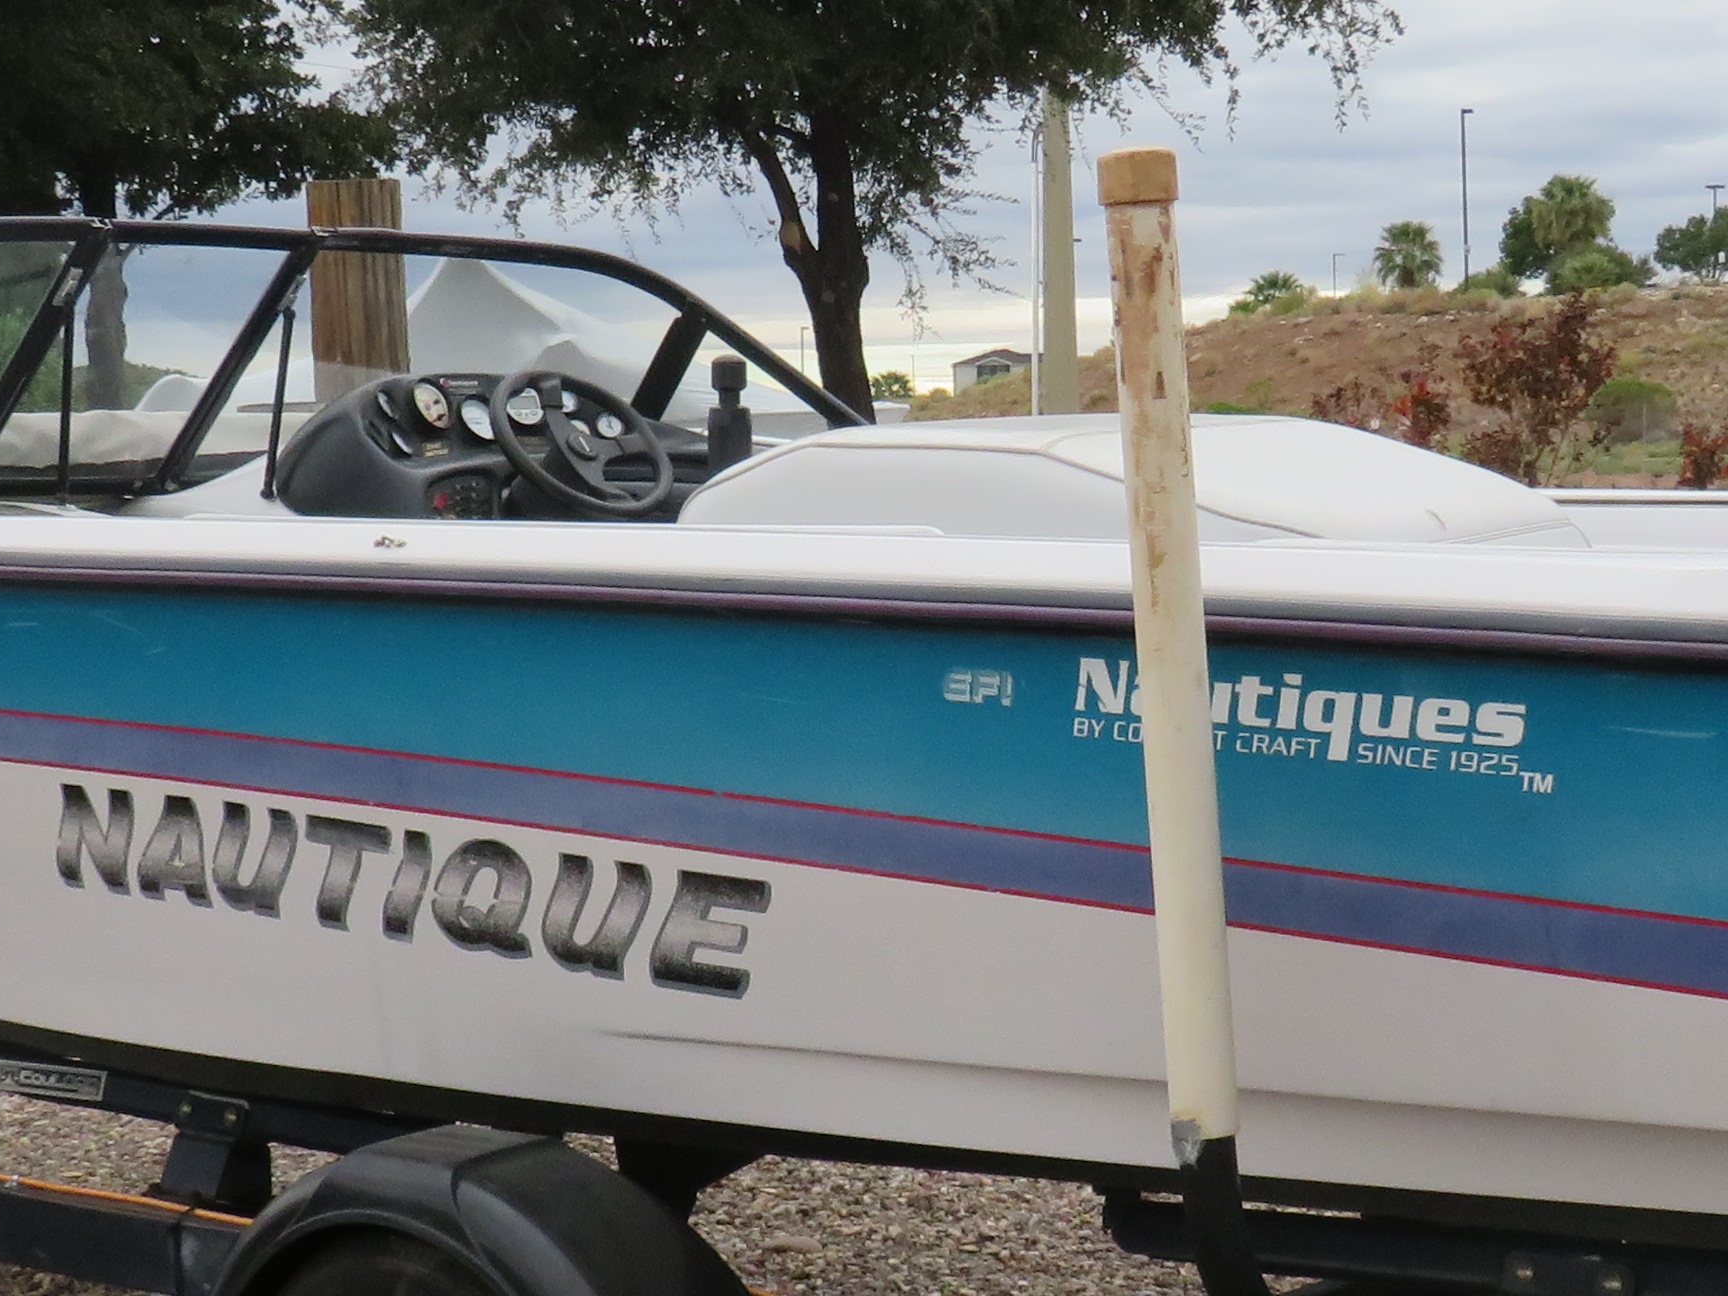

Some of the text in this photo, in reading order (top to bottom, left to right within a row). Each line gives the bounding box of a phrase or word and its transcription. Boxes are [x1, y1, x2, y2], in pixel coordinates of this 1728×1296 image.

[1073, 717, 1105, 738] BY
[1235, 733, 1321, 759] CRAFT
[1356, 743, 1440, 771] SINCE
[1449, 750, 1520, 777] 1925
[1521, 771, 1555, 794] TM
[54, 782, 772, 999] NAUTIQUE
